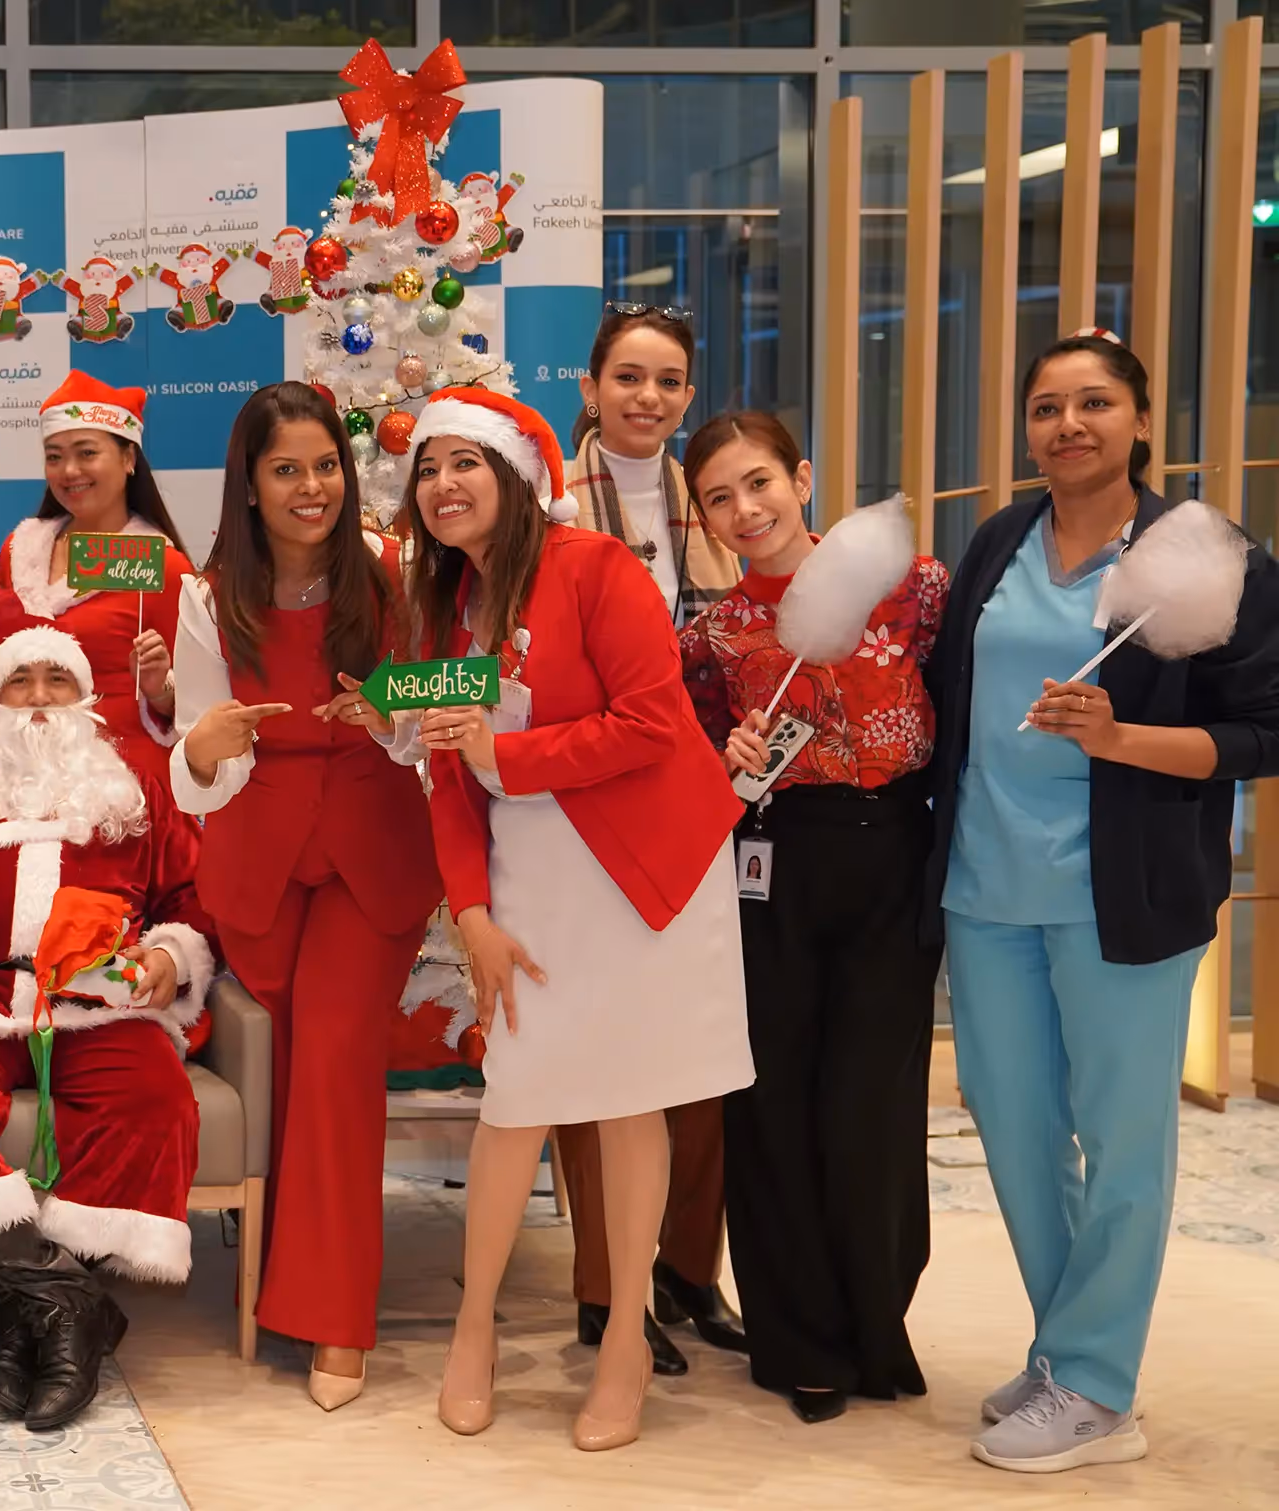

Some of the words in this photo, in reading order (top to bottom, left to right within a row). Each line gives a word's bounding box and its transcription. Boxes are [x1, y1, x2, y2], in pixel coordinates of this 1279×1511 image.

[533, 216, 581, 229] Fakeeh
[161, 383, 214, 395] SILICON
[218, 380, 259, 393] OASIS
[86, 537, 151, 560] SLEIGH
[107, 559, 128, 579] all
[130, 559, 157, 585] day
[386, 662, 488, 701] Naughty
